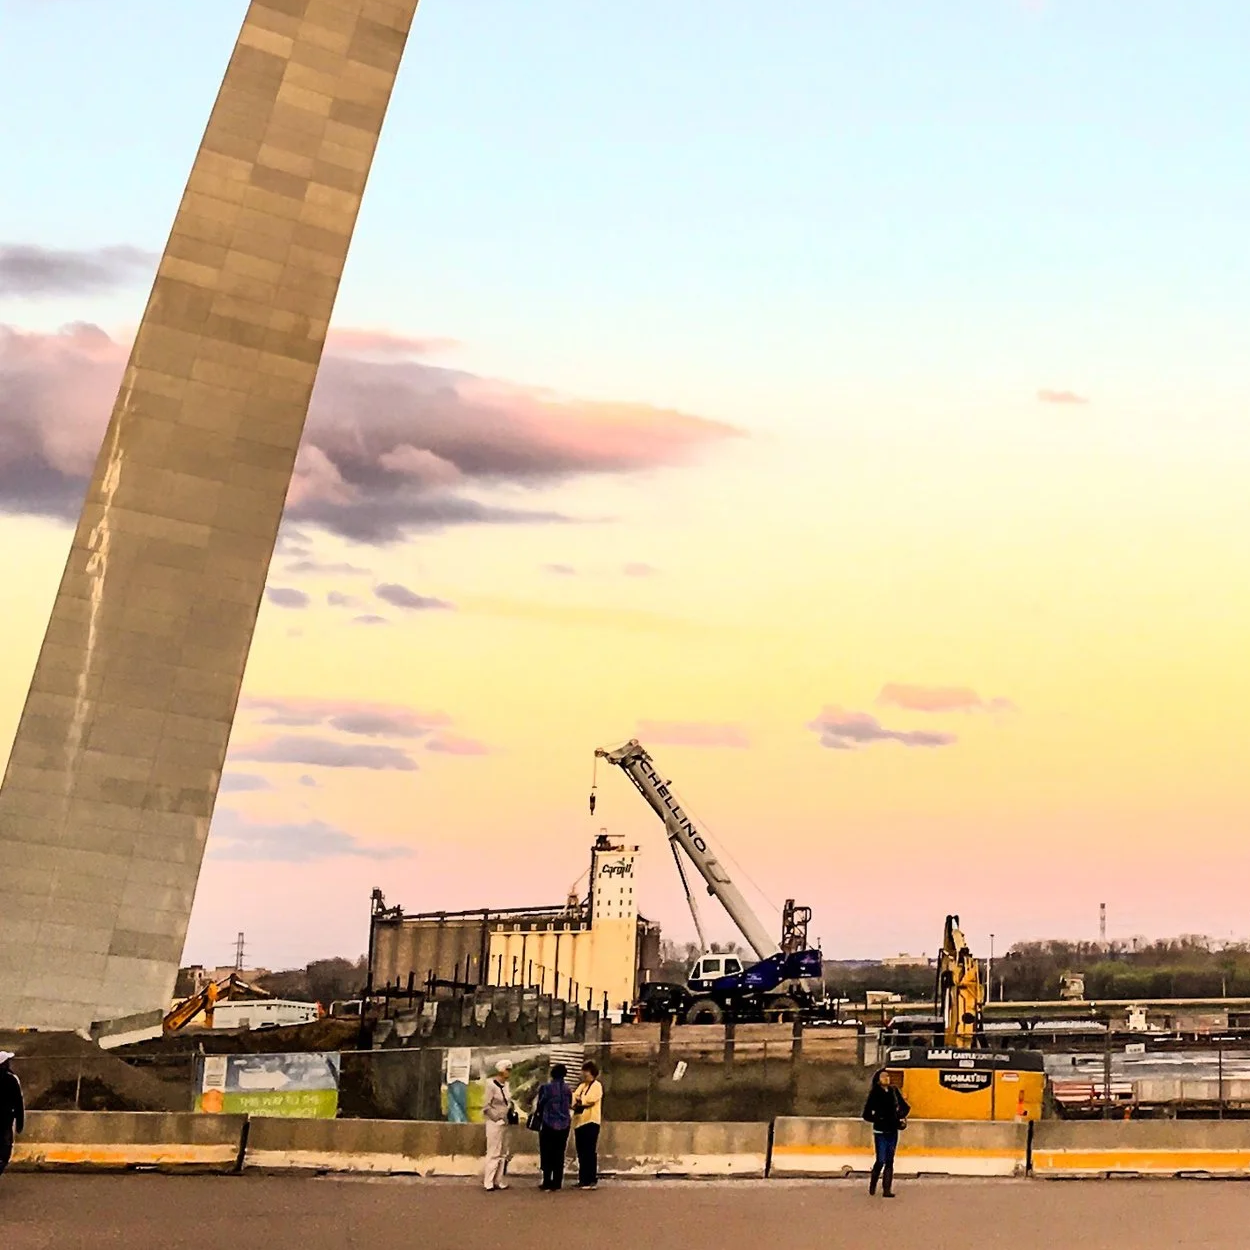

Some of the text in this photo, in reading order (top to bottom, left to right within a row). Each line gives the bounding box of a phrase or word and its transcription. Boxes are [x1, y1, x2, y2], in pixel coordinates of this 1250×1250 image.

[640, 760, 706, 853] CHELLINO
[602, 864, 632, 875] Cargill
[944, 1073, 988, 1083] KOMATSU
